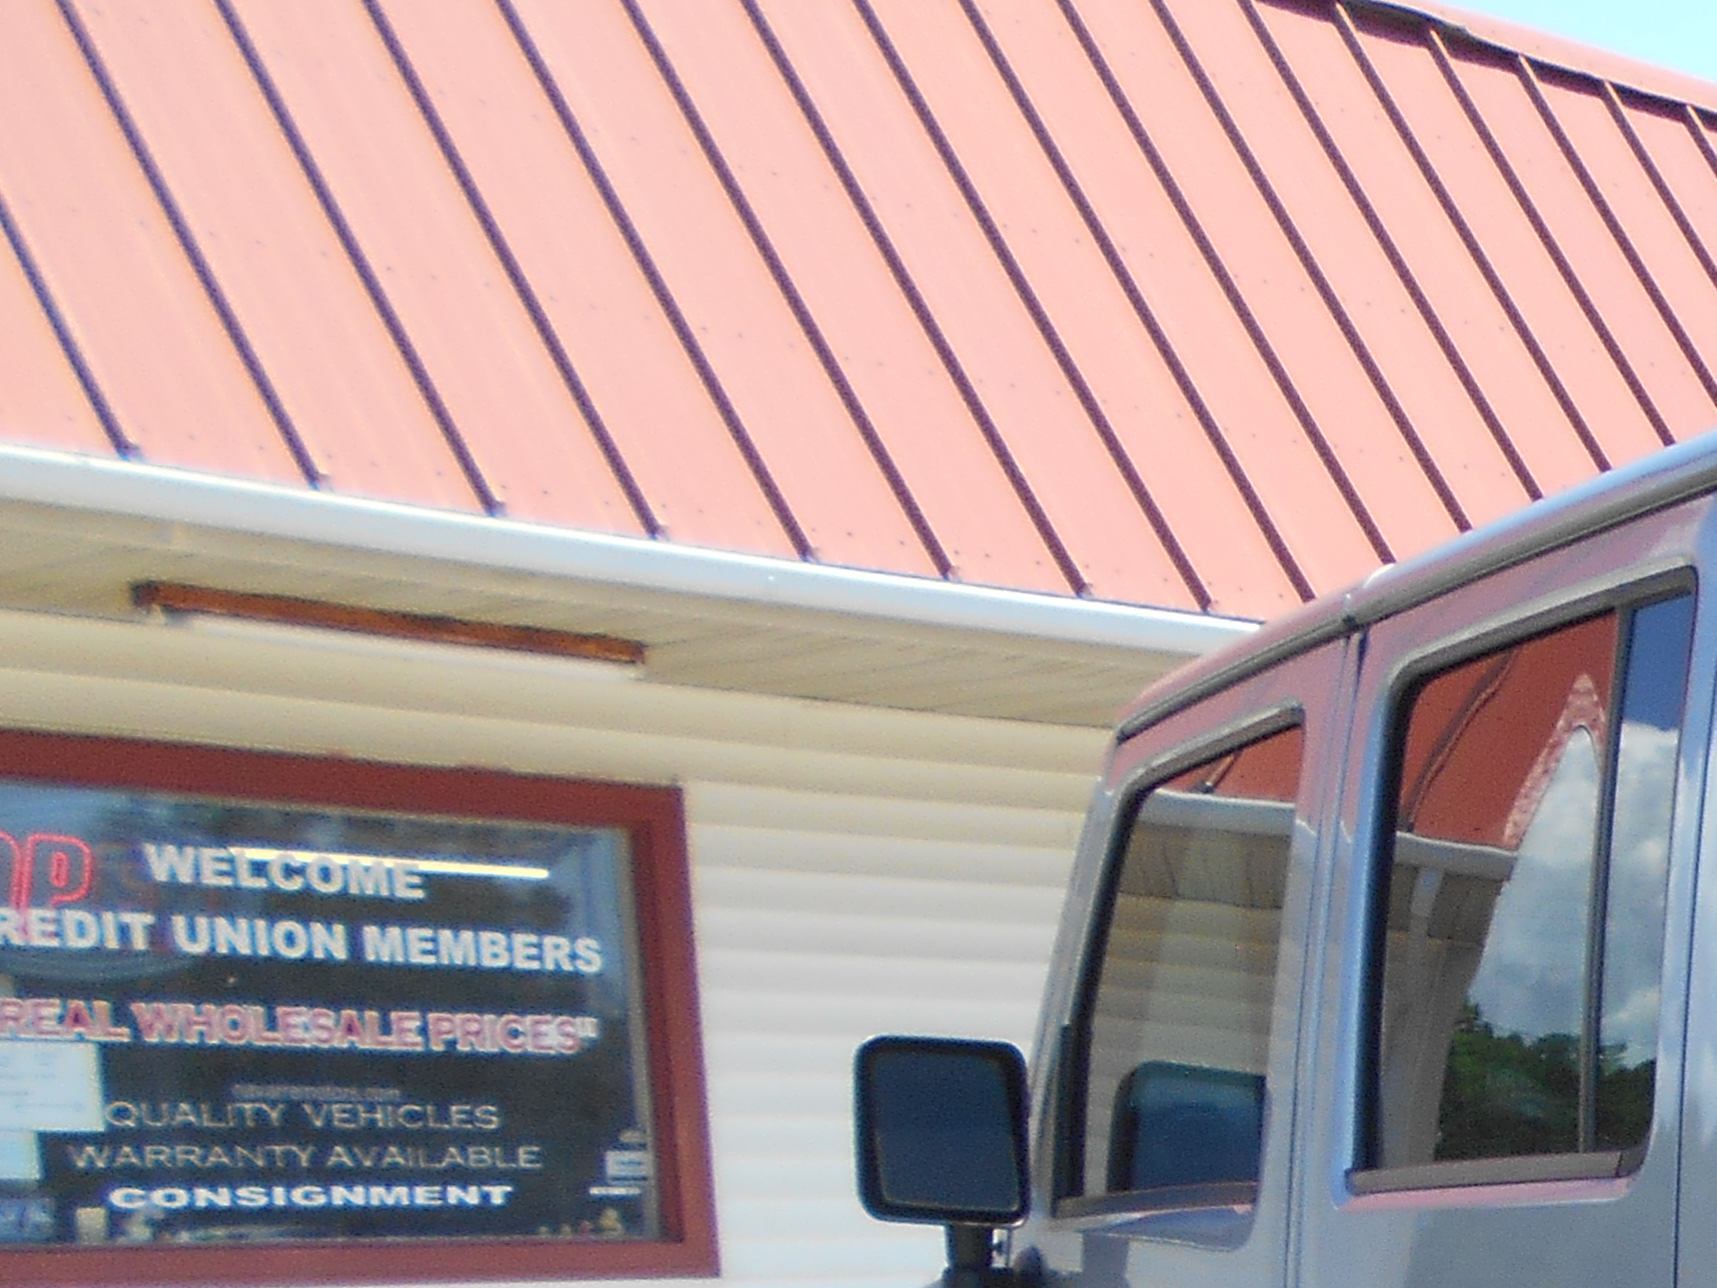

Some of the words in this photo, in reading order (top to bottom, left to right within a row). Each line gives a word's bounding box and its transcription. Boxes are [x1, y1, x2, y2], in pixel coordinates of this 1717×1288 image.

[144, 842, 426, 899] WELCOME
[171, 913, 347, 960] UNION
[362, 924, 602, 973] MEMBERS
[130, 1001, 425, 1050] WHOLESALE
[105, 1100, 286, 1128] QUALITY
[302, 1102, 501, 1129] VEHICLES
[69, 1144, 317, 1168] WARRANTY
[326, 1145, 544, 1169] AVAILABLE
[107, 1185, 514, 1208] CONSIGNMENT
